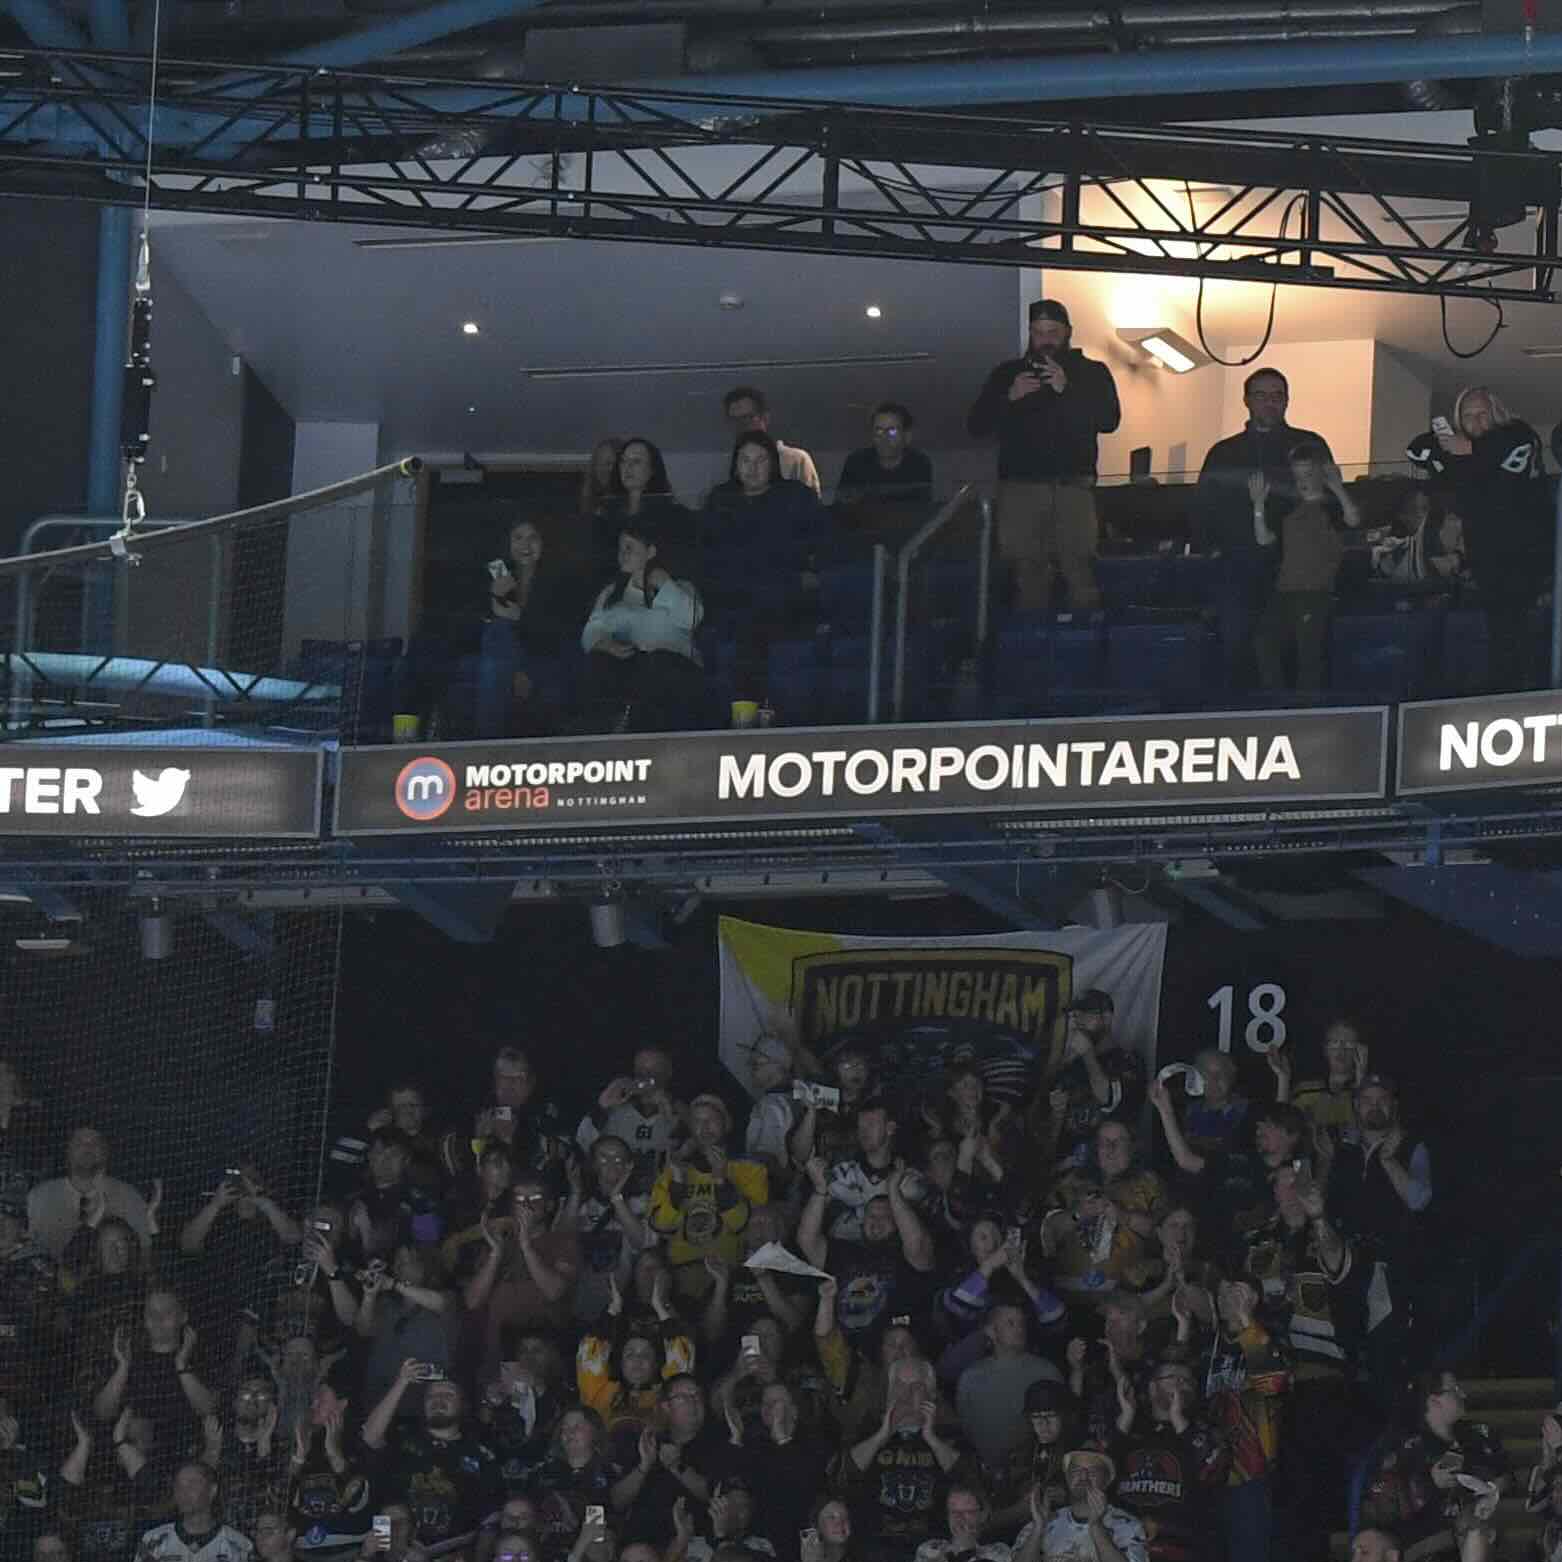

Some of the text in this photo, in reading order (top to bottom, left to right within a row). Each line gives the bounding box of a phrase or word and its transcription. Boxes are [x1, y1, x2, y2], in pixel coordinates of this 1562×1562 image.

[465, 758, 652, 788] MOTORPOINT
[465, 784, 647, 811] arena NOTTINGHAM
[718, 735, 1300, 799] MOTORPOINTARENA
[815, 969, 1047, 1034] NOTTINGHAM
[1207, 983, 1287, 1054] 18
